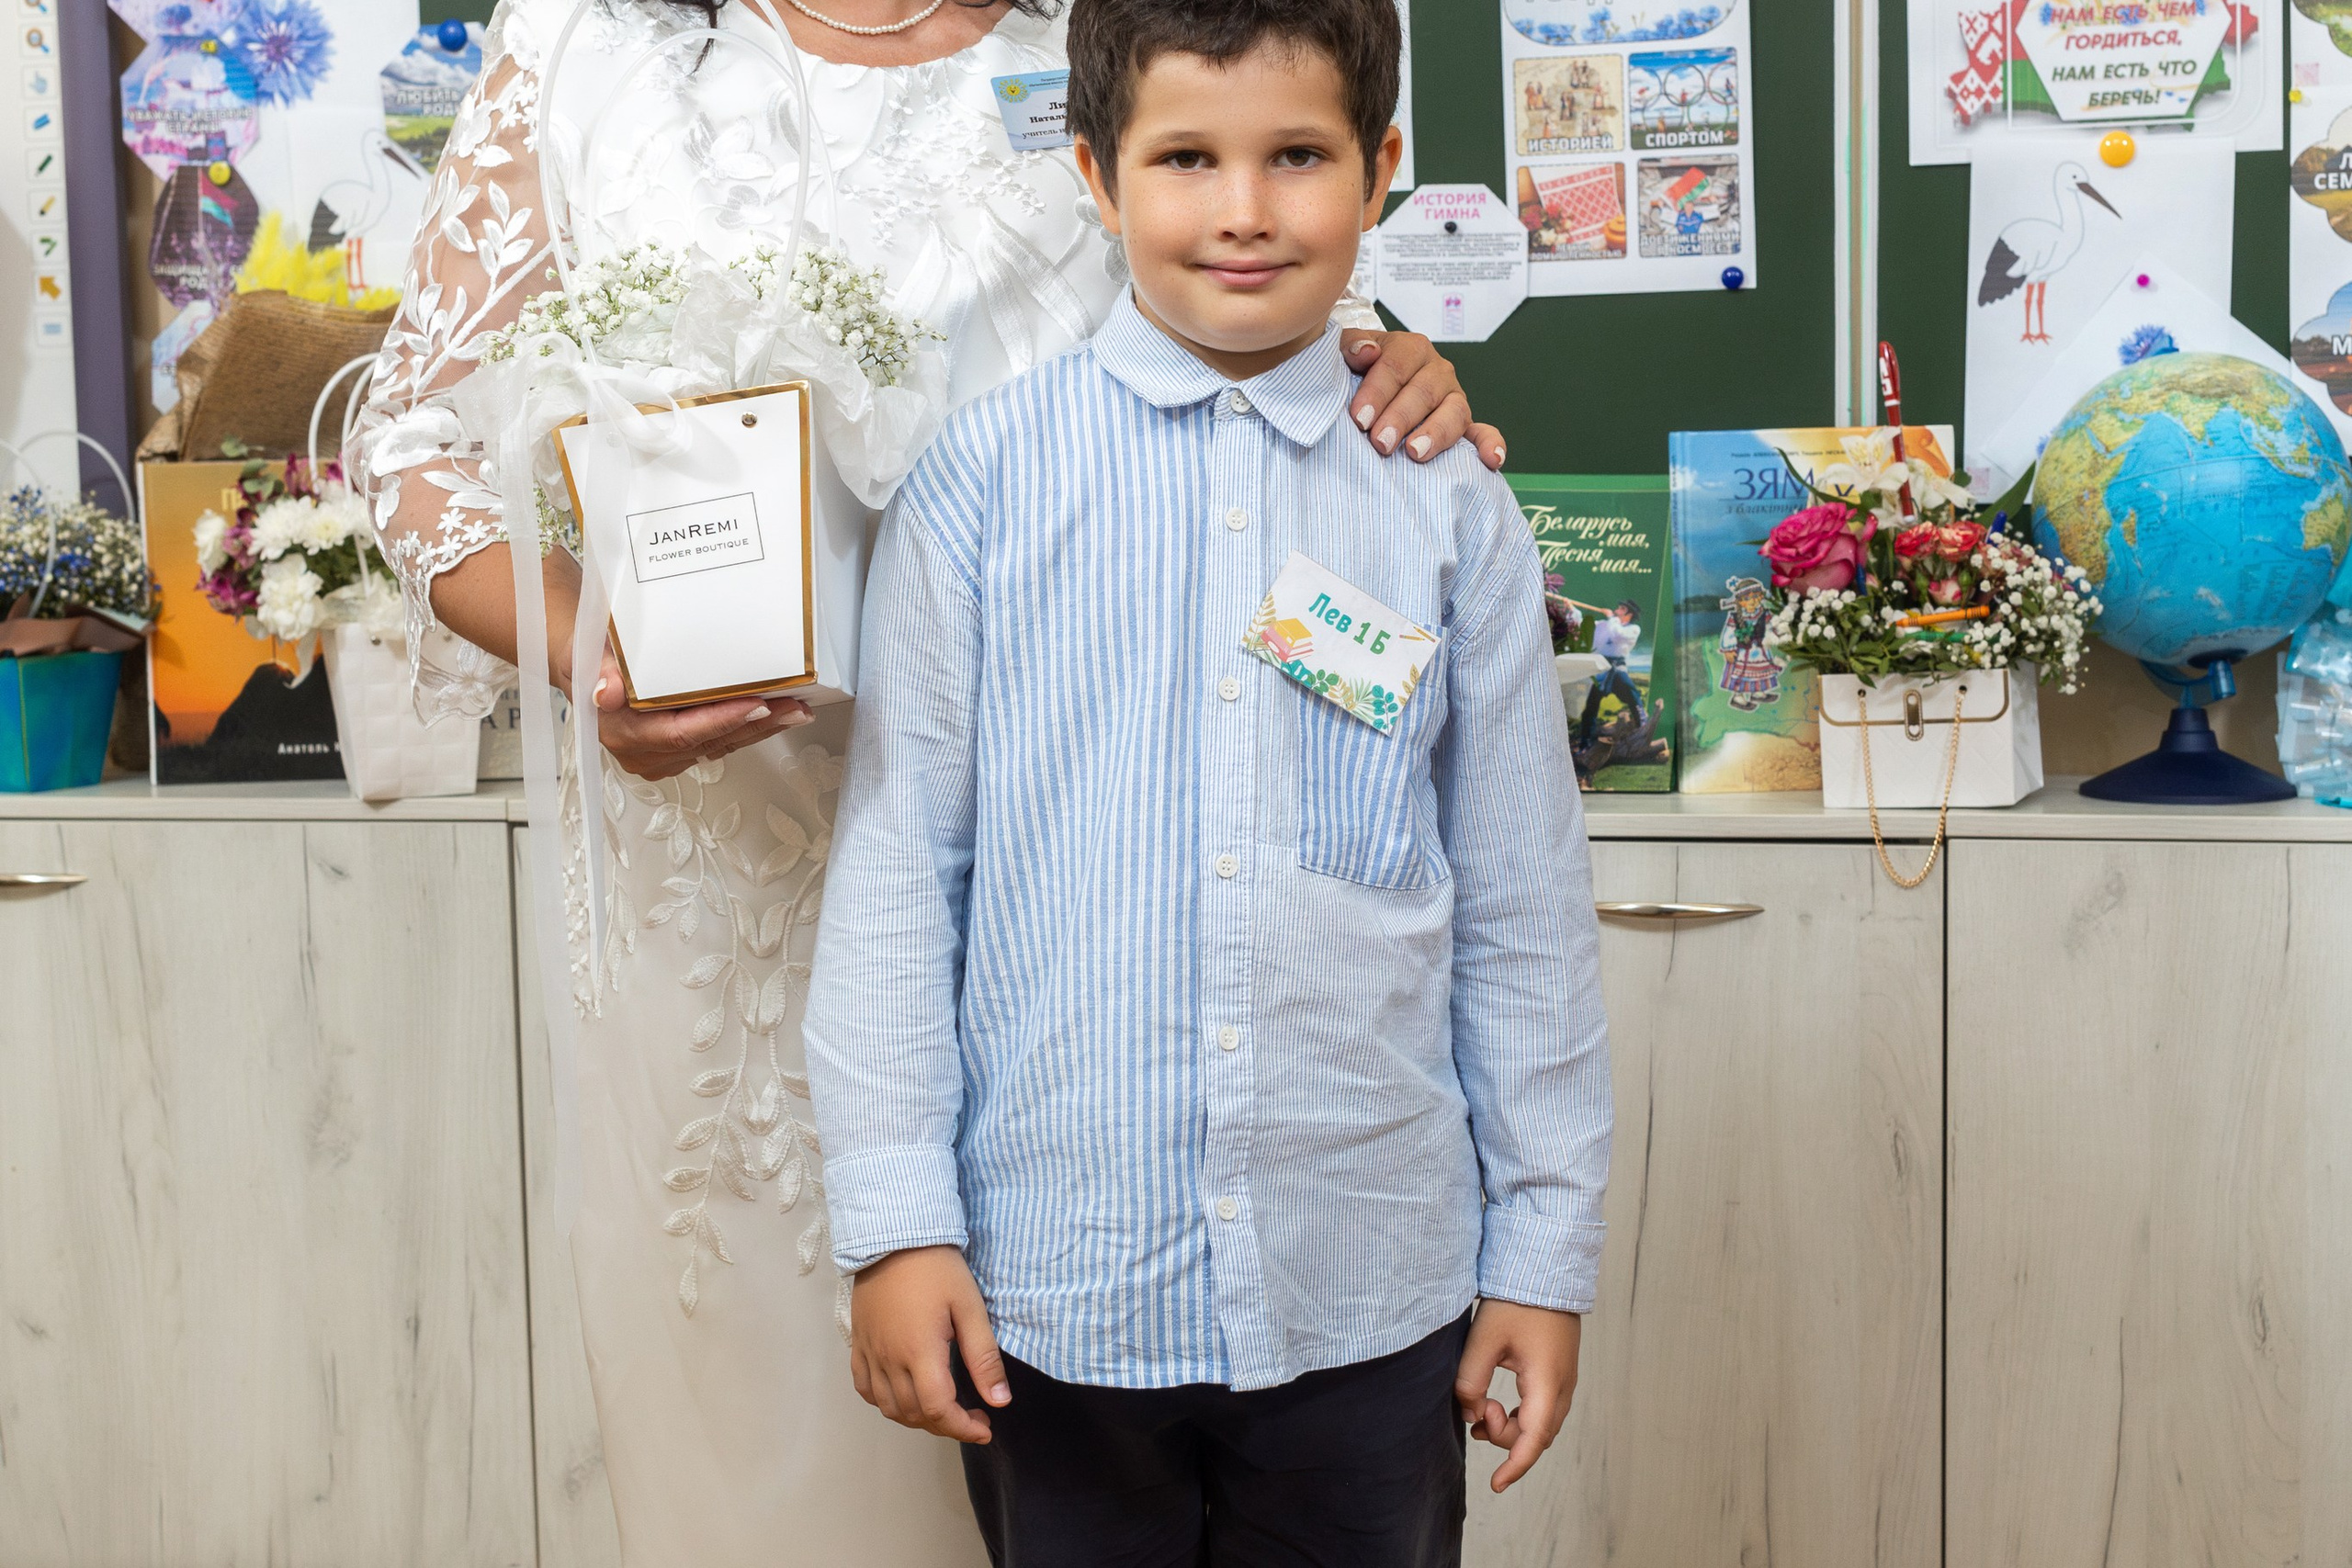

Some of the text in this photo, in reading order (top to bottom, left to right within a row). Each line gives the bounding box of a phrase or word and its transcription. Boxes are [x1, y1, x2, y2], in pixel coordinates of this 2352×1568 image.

[2050, 2, 2197, 23] НАМ ЕСТЬ ЧЕМ
[2064, 29, 2183, 51] ГОРДИТЬСЯ,
[2051, 60, 2198, 82] НАМ ЕСТЬ ЧТО
[2087, 89, 2162, 108] БЕРЕЧЬ!
[1528, 136, 1615, 152] ИСТОРИЕЙ
[1645, 130, 1724, 148] СПОРТОМ
[1413, 193, 1487, 206] ИСТОРИЯ
[1424, 208, 1481, 220] ГИМНА
[1521, 505, 1634, 540] Беларусь
[649, 538, 750, 563] FLOWER BOUTIQUE
[1536, 539, 1604, 571] Песня
[1308, 592, 1391, 655] Лев 1 Б
